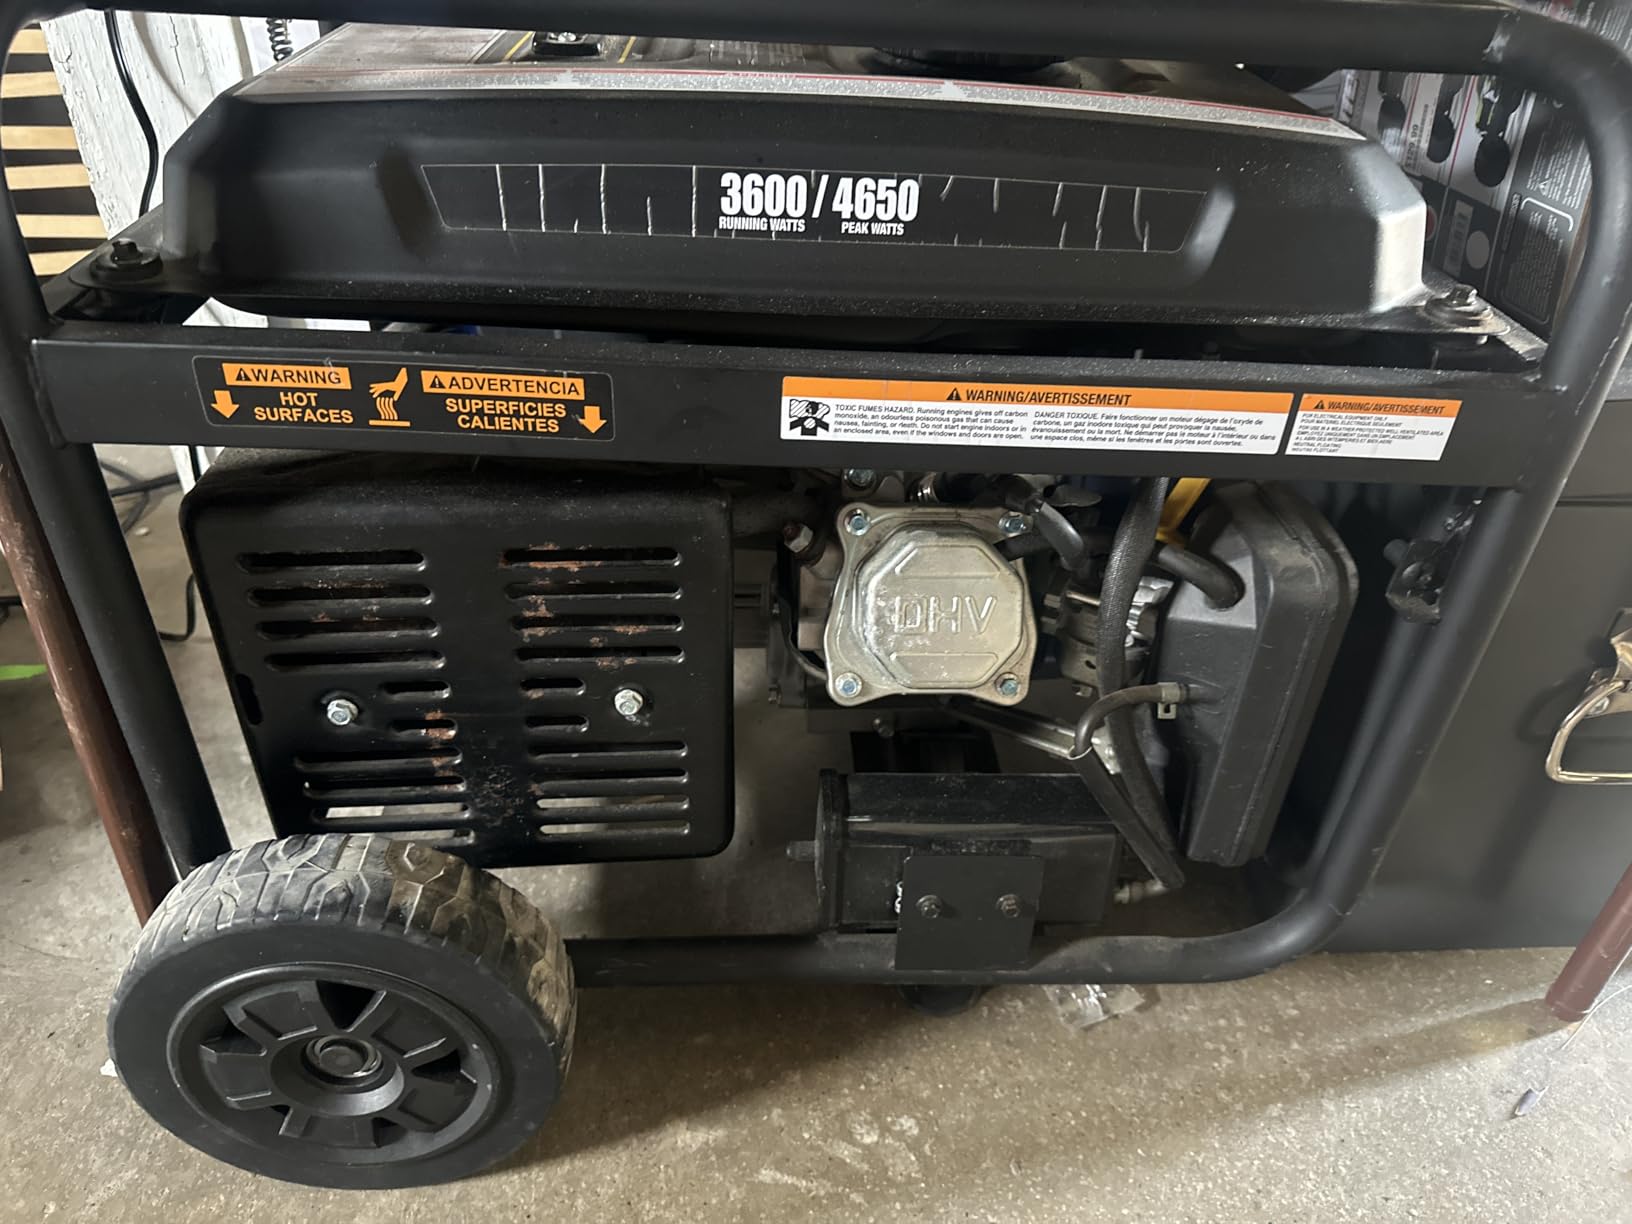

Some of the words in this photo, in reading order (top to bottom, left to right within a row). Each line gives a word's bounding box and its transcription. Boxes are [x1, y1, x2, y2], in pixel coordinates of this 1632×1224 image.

[720, 172, 807, 217] 3600
[812, 175, 829, 218] /
[832, 177, 919, 222] 4650
[719, 217, 767, 231] RUNNING
[770, 219, 805, 232] WATTS
[841, 222, 868, 234] PEAK
[871, 223, 904, 236] WATTS
[250, 368, 341, 385] WARNING
[449, 378, 580, 395] ADVERTENCIA
[280, 391, 318, 407] HOT
[966, 390, 1131, 406] WARNING/AVERTISSEMENT
[254, 407, 354, 424] SURFACES
[446, 399, 566, 418] SUPERFICIES
[917, 407, 945, 415] Running
[975, 409, 992, 417] gives
[1328, 402, 1445, 414] WARNING/AVERTISSEMENT
[457, 415, 559, 433] CALIENTES
